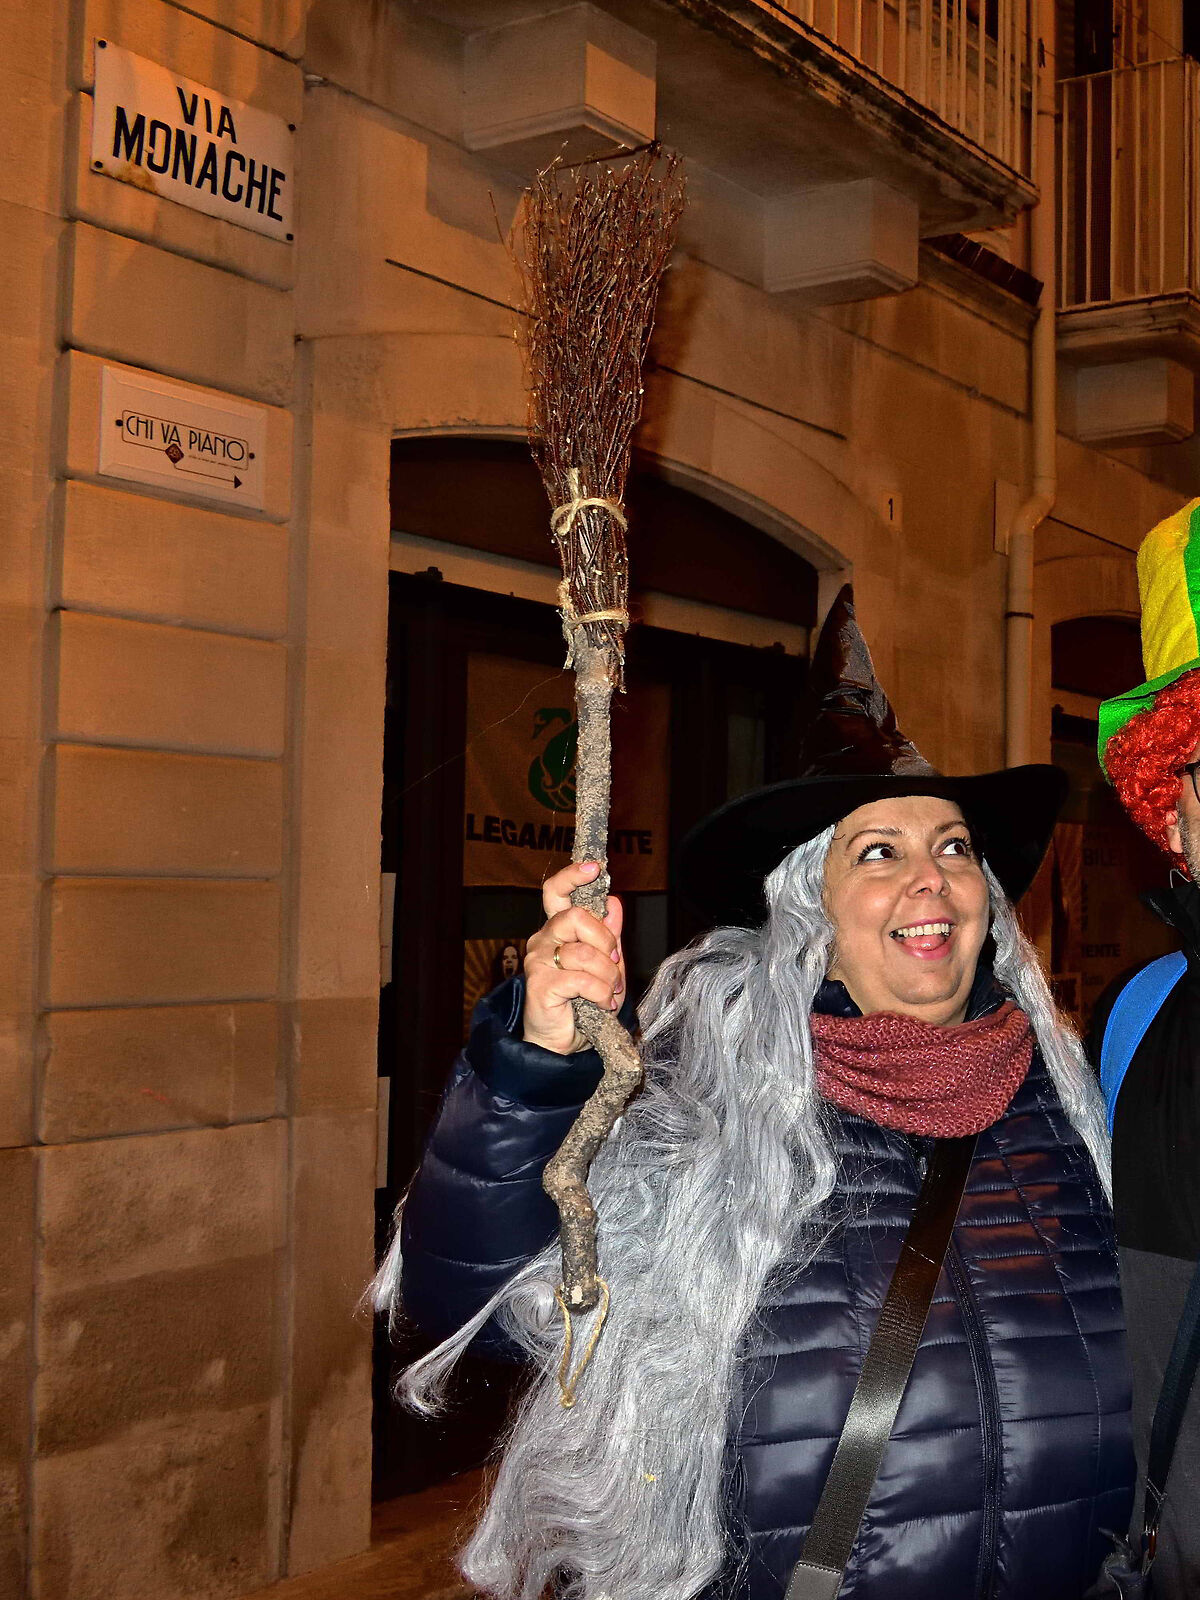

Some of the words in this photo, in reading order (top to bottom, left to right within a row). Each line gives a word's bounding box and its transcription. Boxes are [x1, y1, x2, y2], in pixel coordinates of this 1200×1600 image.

[176, 86, 237, 144] VIA
[112, 105, 286, 222] MONACHE
[126, 415, 153, 440] CHI
[161, 422, 182, 447] VA
[189, 429, 245, 461] PIANO
